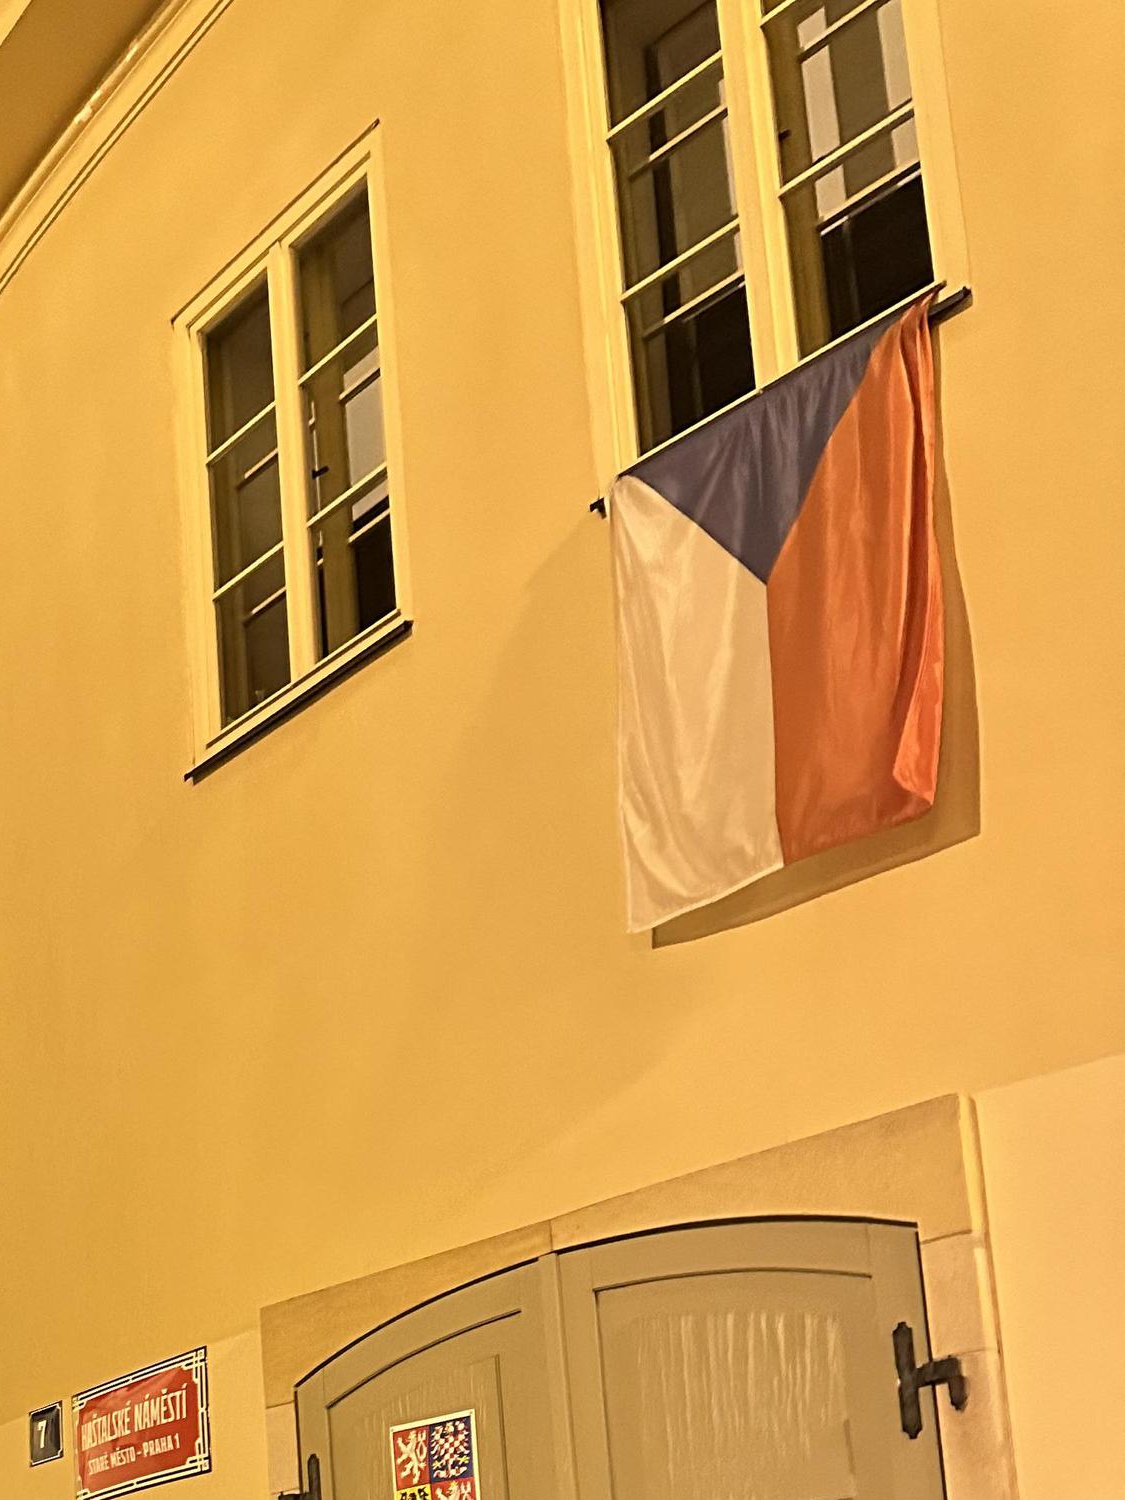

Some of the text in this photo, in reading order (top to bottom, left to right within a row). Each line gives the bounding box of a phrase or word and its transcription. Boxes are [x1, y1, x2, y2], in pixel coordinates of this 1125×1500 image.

[37, 1420, 47, 1449] 7
[81, 1383, 188, 1452] HAŠTALSKÉ NÁMĚSTÍ
[110, 1447, 136, 1469] MĚSTO
[142, 1434, 173, 1458] PRAHA
[174, 1433, 180, 1449] 1
